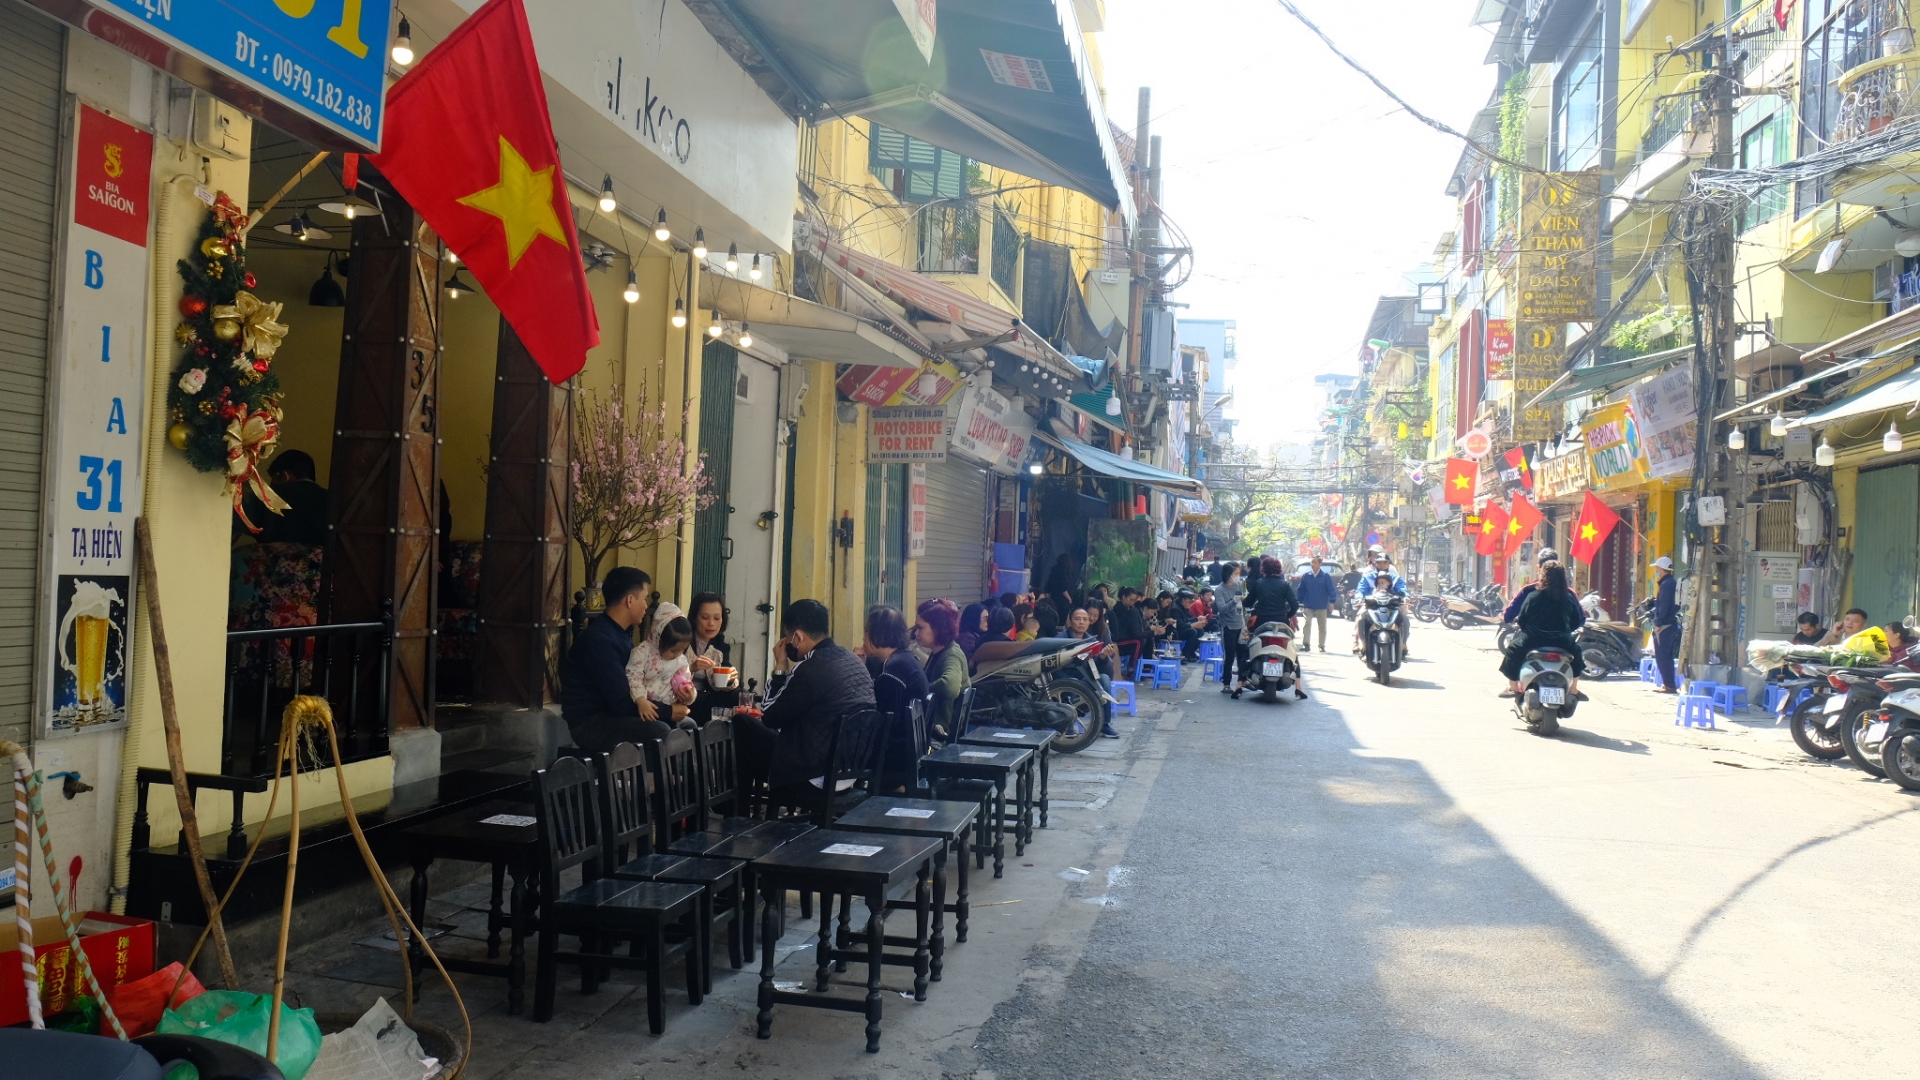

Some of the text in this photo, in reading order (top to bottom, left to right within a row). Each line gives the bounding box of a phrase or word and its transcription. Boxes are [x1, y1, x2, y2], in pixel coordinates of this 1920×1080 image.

[272, 53, 372, 131] 0979.182.838
[105, 181, 120, 195] BIA
[88, 184, 135, 216] SAIGON
[1529, 276, 1582, 287] DAISY
[1518, 354, 1563, 366] DAISY
[872, 409, 891, 420] Shop
[892, 409, 902, 418] 37
[1525, 409, 1551, 421] SPA
[873, 421, 942, 436] MOTORBIKE
[878, 436, 935, 451] FOR RENT
[1592, 444, 1630, 479] WORLD
[76, 455, 123, 513] 31
[71, 521, 123, 567] TẠ HIỆN
